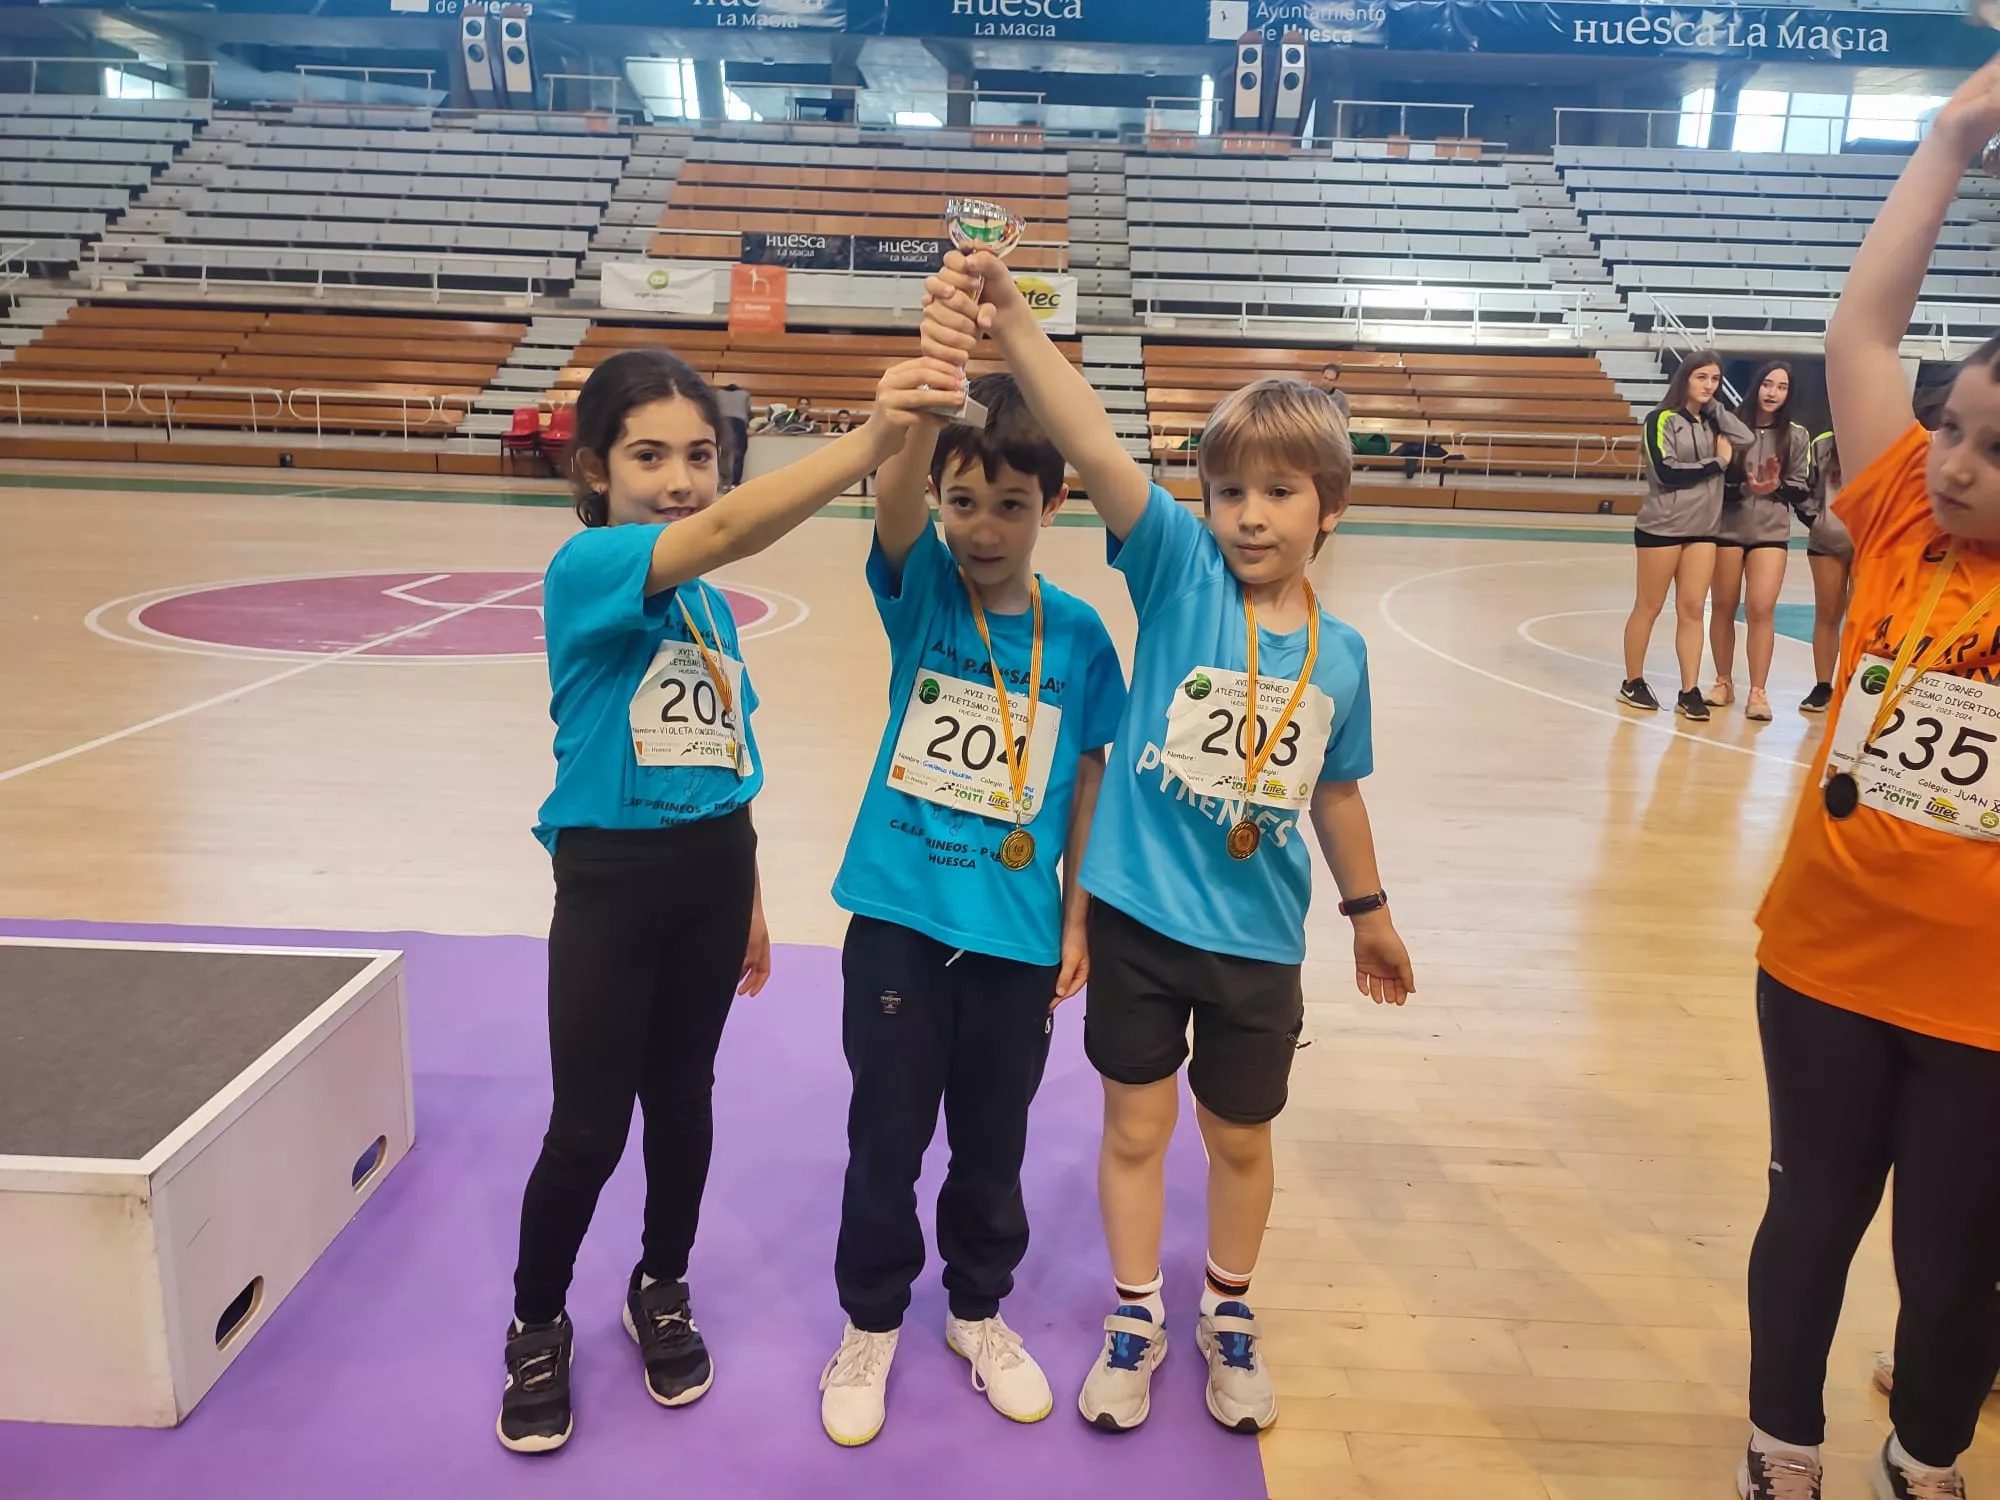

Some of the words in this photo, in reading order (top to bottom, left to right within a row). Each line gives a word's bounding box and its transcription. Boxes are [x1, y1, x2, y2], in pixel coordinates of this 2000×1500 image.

[1256, 2, 1387, 25] Ayuntamiento
[974, 22, 995, 36] La
[1020, 289, 1062, 306] tec
[964, 688, 984, 699] XVII
[987, 694, 1018, 709] TOEO
[1943, 681, 1983, 699] TORNEO
[942, 694, 989, 712] ATLETISMO
[926, 715, 1027, 771] 204
[1201, 708, 1300, 767] 203
[1864, 708, 1998, 786] 235
[1882, 790, 1920, 811] ZOITI
[1886, 783, 1923, 800] ATLETISMO
[1953, 787, 1989, 808] JUAN
[929, 853, 976, 869] HUESCA
